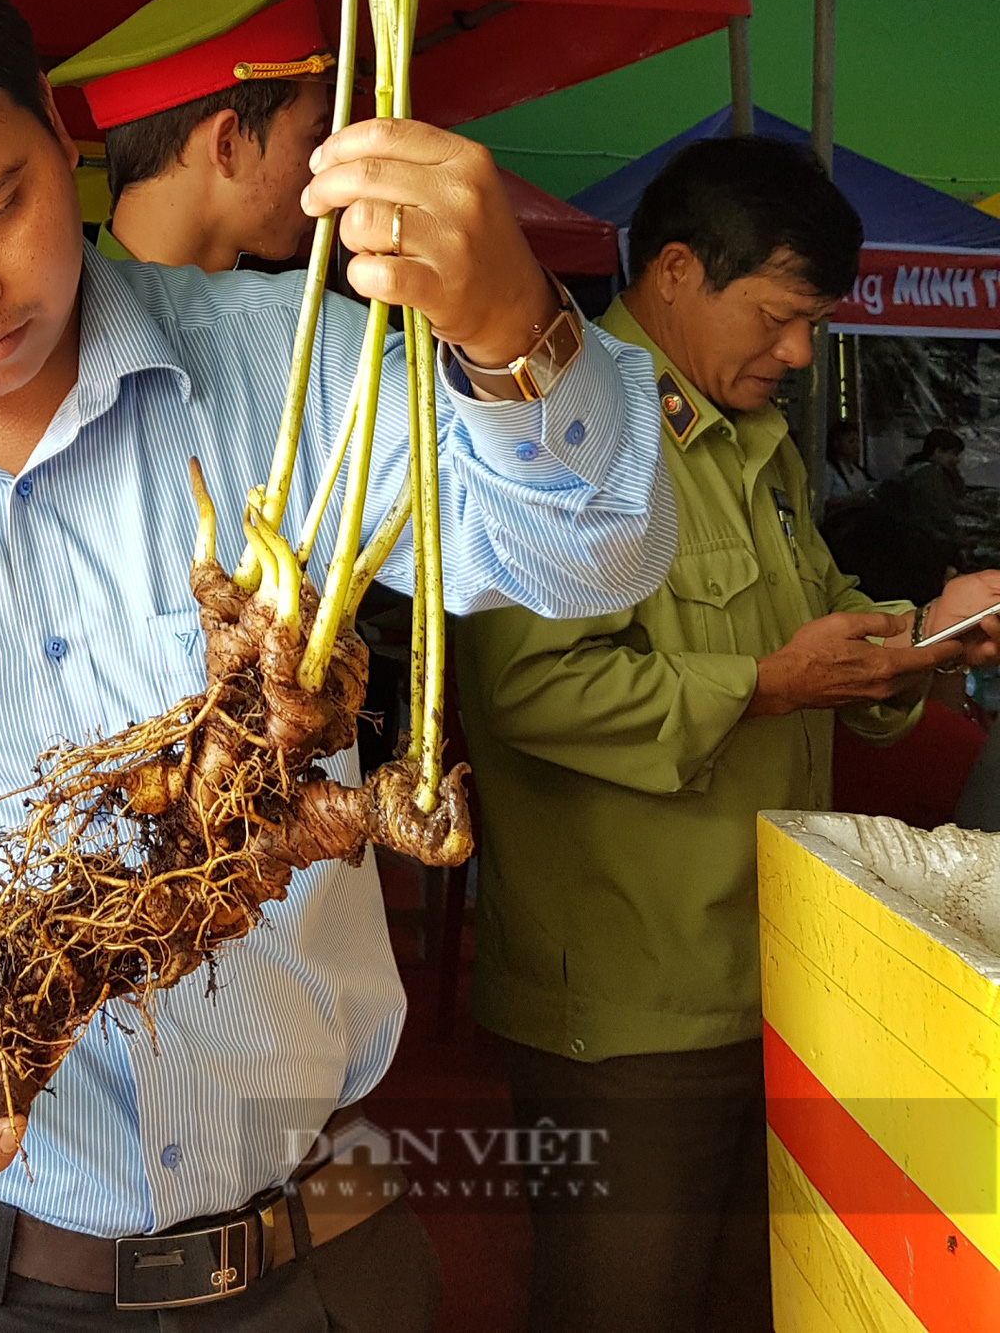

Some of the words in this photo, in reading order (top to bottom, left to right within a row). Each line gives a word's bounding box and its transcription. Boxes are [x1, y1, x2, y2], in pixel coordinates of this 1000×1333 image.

[842, 275, 884, 315] ng
[893, 266, 977, 307] MINH
[980, 270, 1000, 308] T
